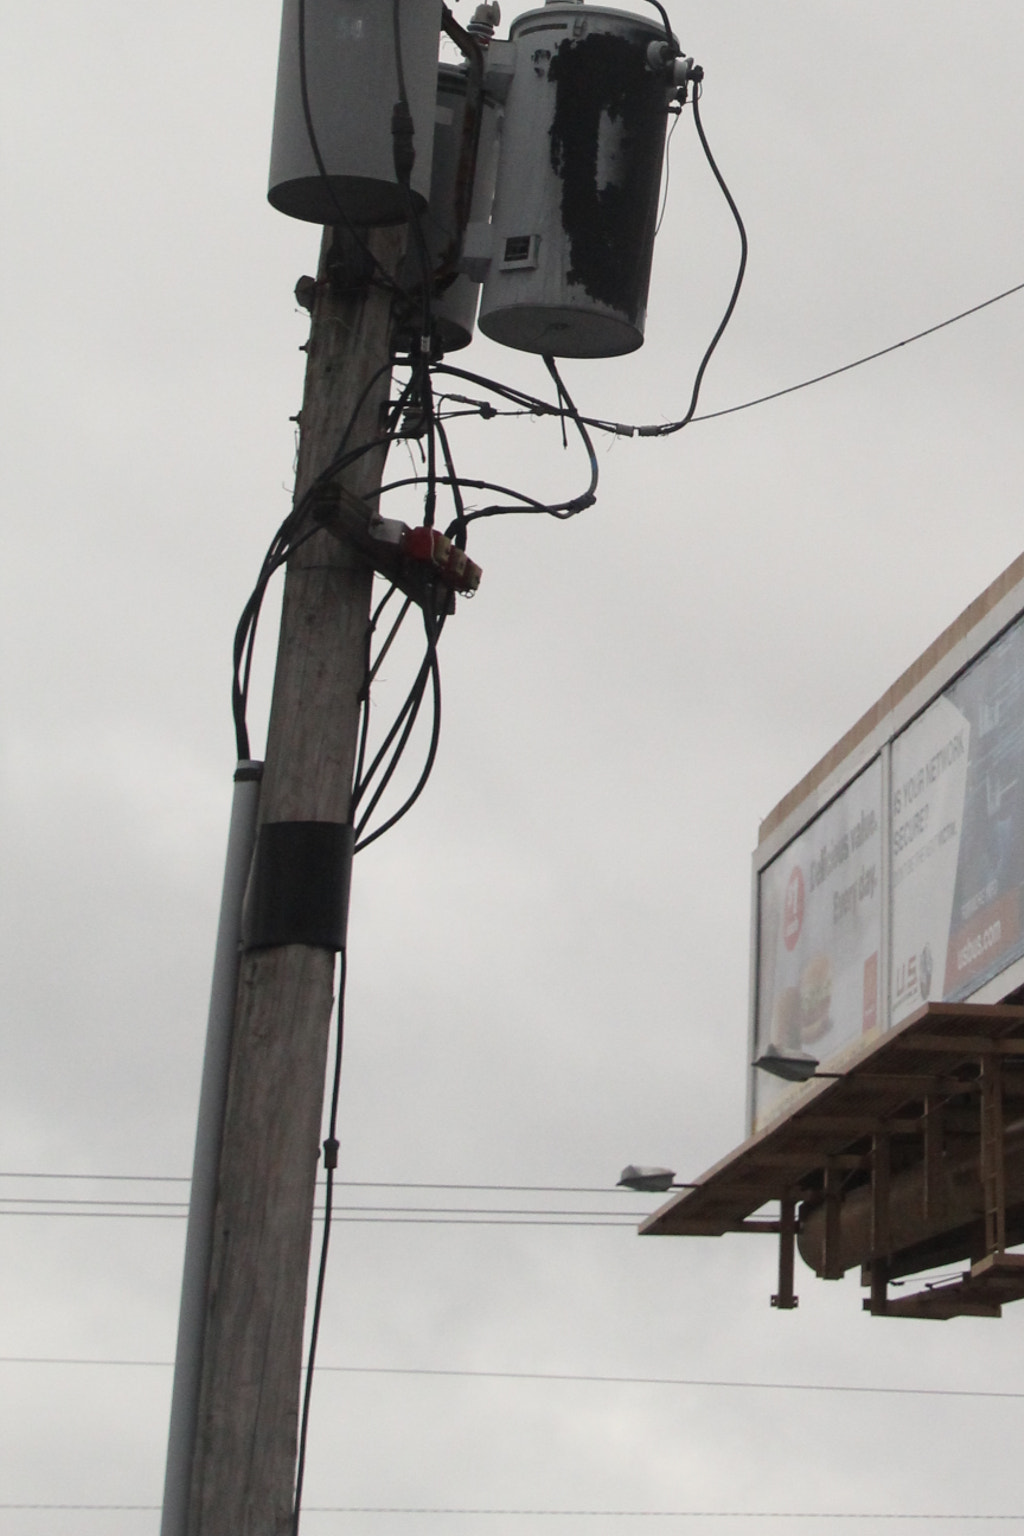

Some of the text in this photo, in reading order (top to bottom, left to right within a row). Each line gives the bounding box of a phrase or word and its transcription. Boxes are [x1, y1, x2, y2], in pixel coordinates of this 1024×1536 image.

[893, 733, 964, 816] IS YOUR NETWORK
[894, 803, 929, 855] SECURE?
